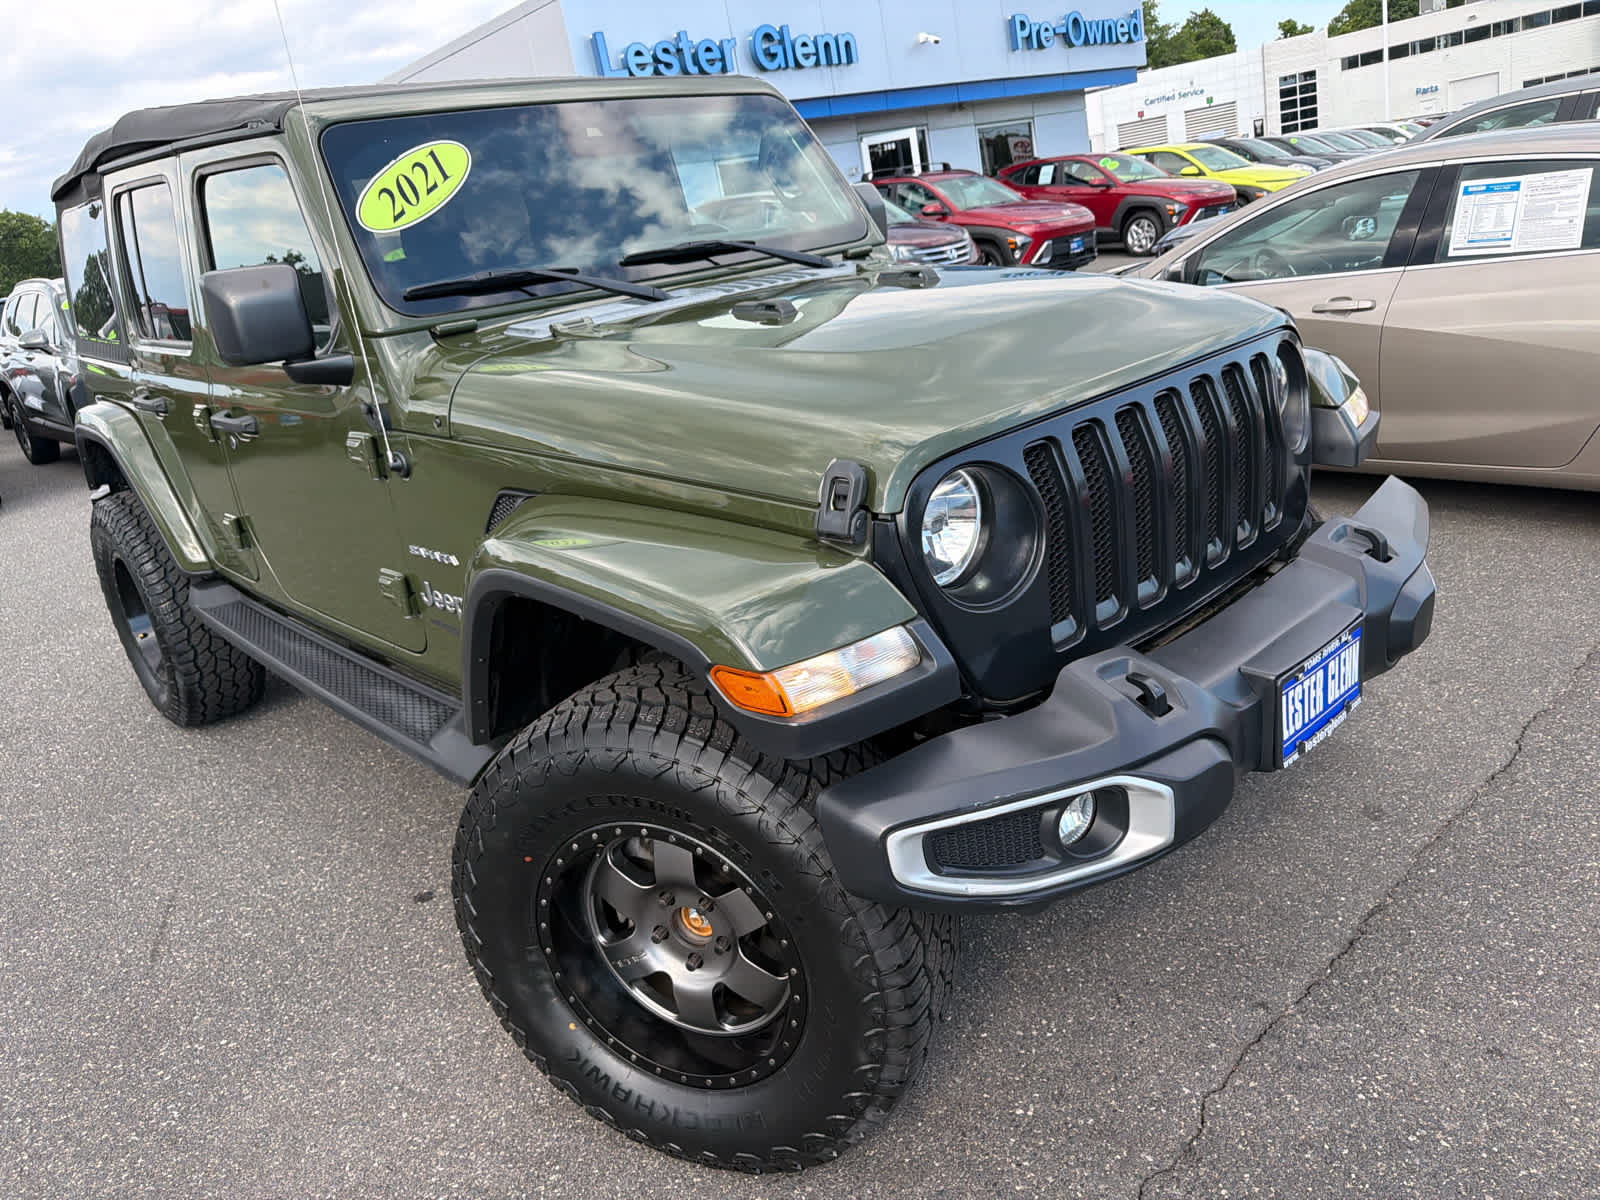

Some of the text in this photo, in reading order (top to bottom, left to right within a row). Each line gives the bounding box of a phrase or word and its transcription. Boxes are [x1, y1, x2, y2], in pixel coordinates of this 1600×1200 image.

[591, 24, 859, 77] Lester Glenn
[1009, 9, 1142, 51] Pre-Owned
[1144, 88, 1204, 106] Certified Service
[378, 149, 453, 223] 2021
[420, 581, 463, 620] Jeep
[1282, 640, 1360, 741] LESTER GLENN
